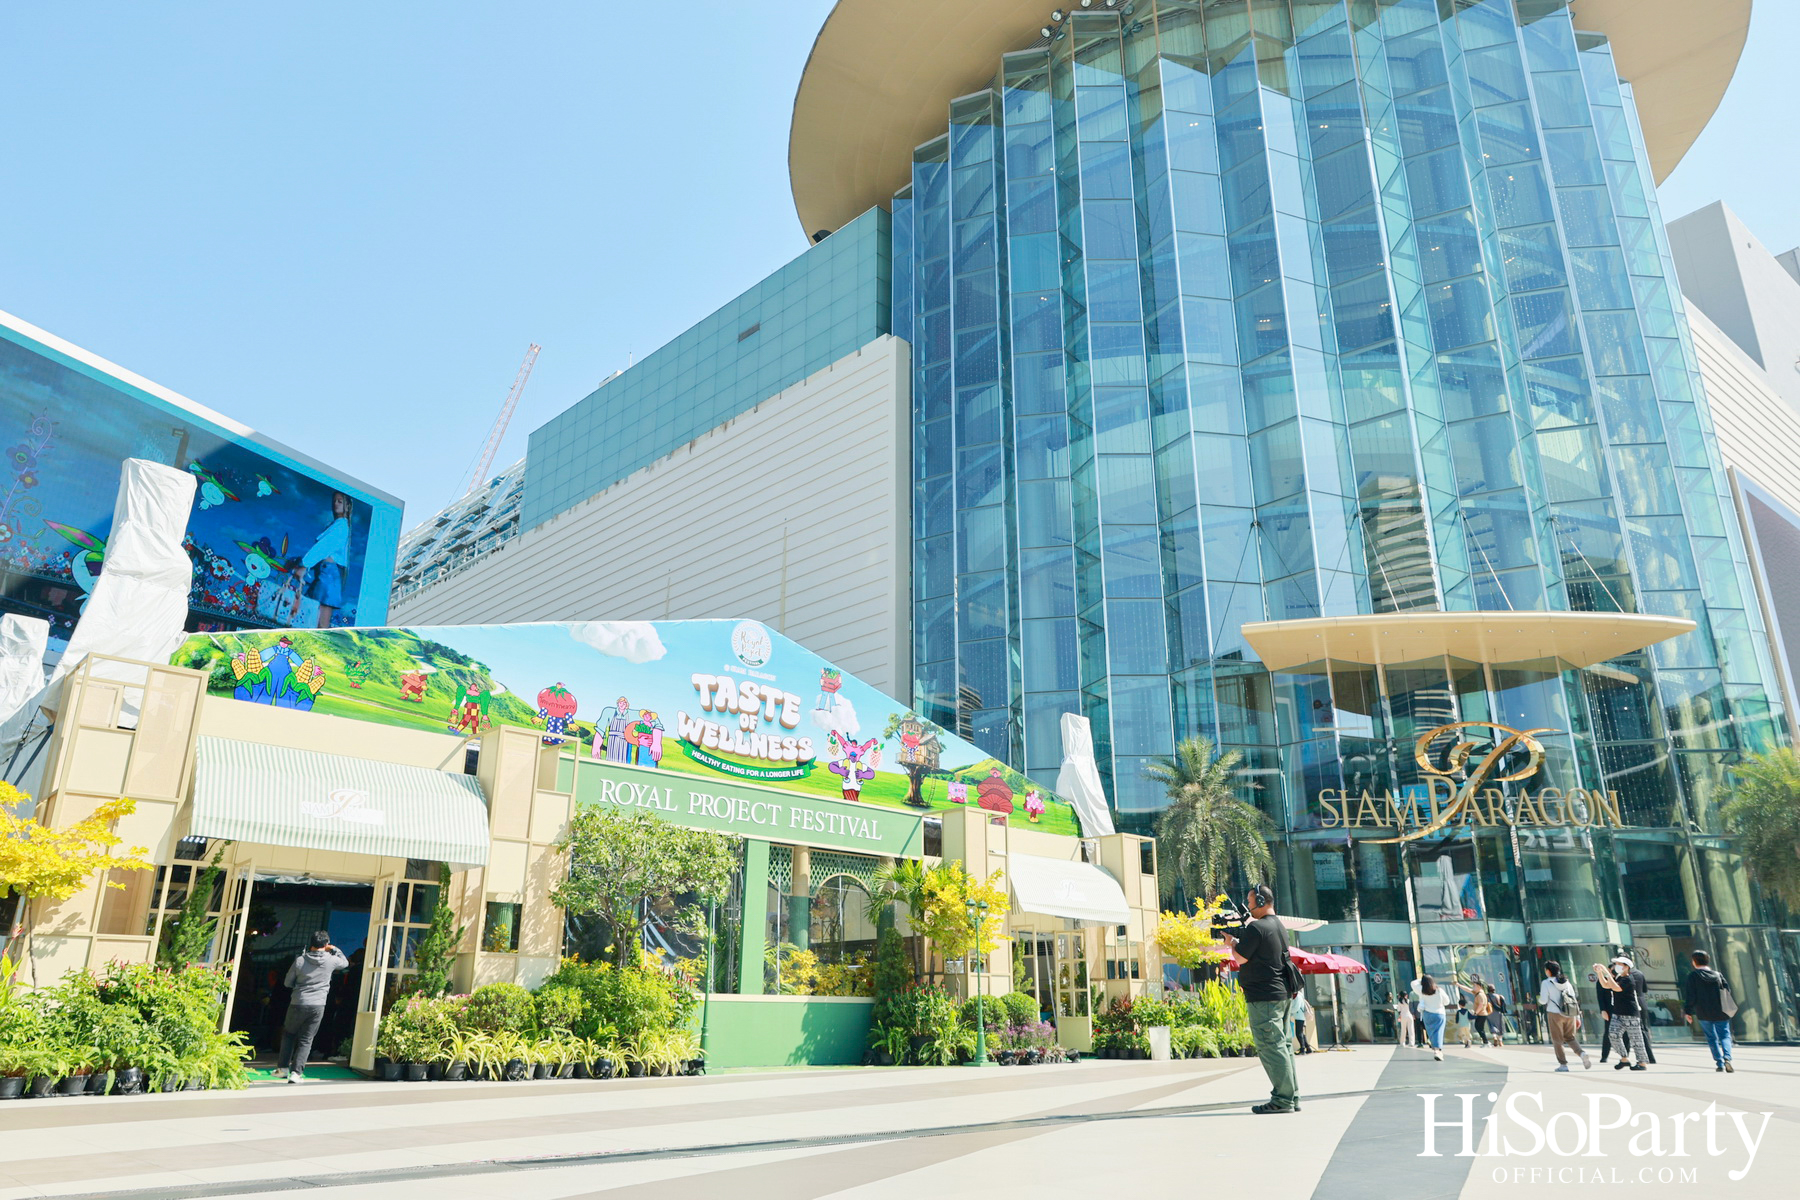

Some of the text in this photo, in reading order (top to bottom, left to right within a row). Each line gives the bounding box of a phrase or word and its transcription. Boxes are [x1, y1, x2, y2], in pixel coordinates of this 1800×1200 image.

[691, 672, 801, 729] TASTE
[739, 713, 758, 732] OF
[677, 710, 814, 762] WELLNESS
[691, 750, 721, 767] HEALTHY
[721, 763, 745, 775] EATING
[746, 768, 759, 777] FOR
[766, 770, 791, 778] LONGER
[791, 769, 804, 777] LIFE
[599, 778, 883, 841] ROYAL PROJECT FESTIVAL
[1318, 775, 1623, 829] SIAM PARAGON
